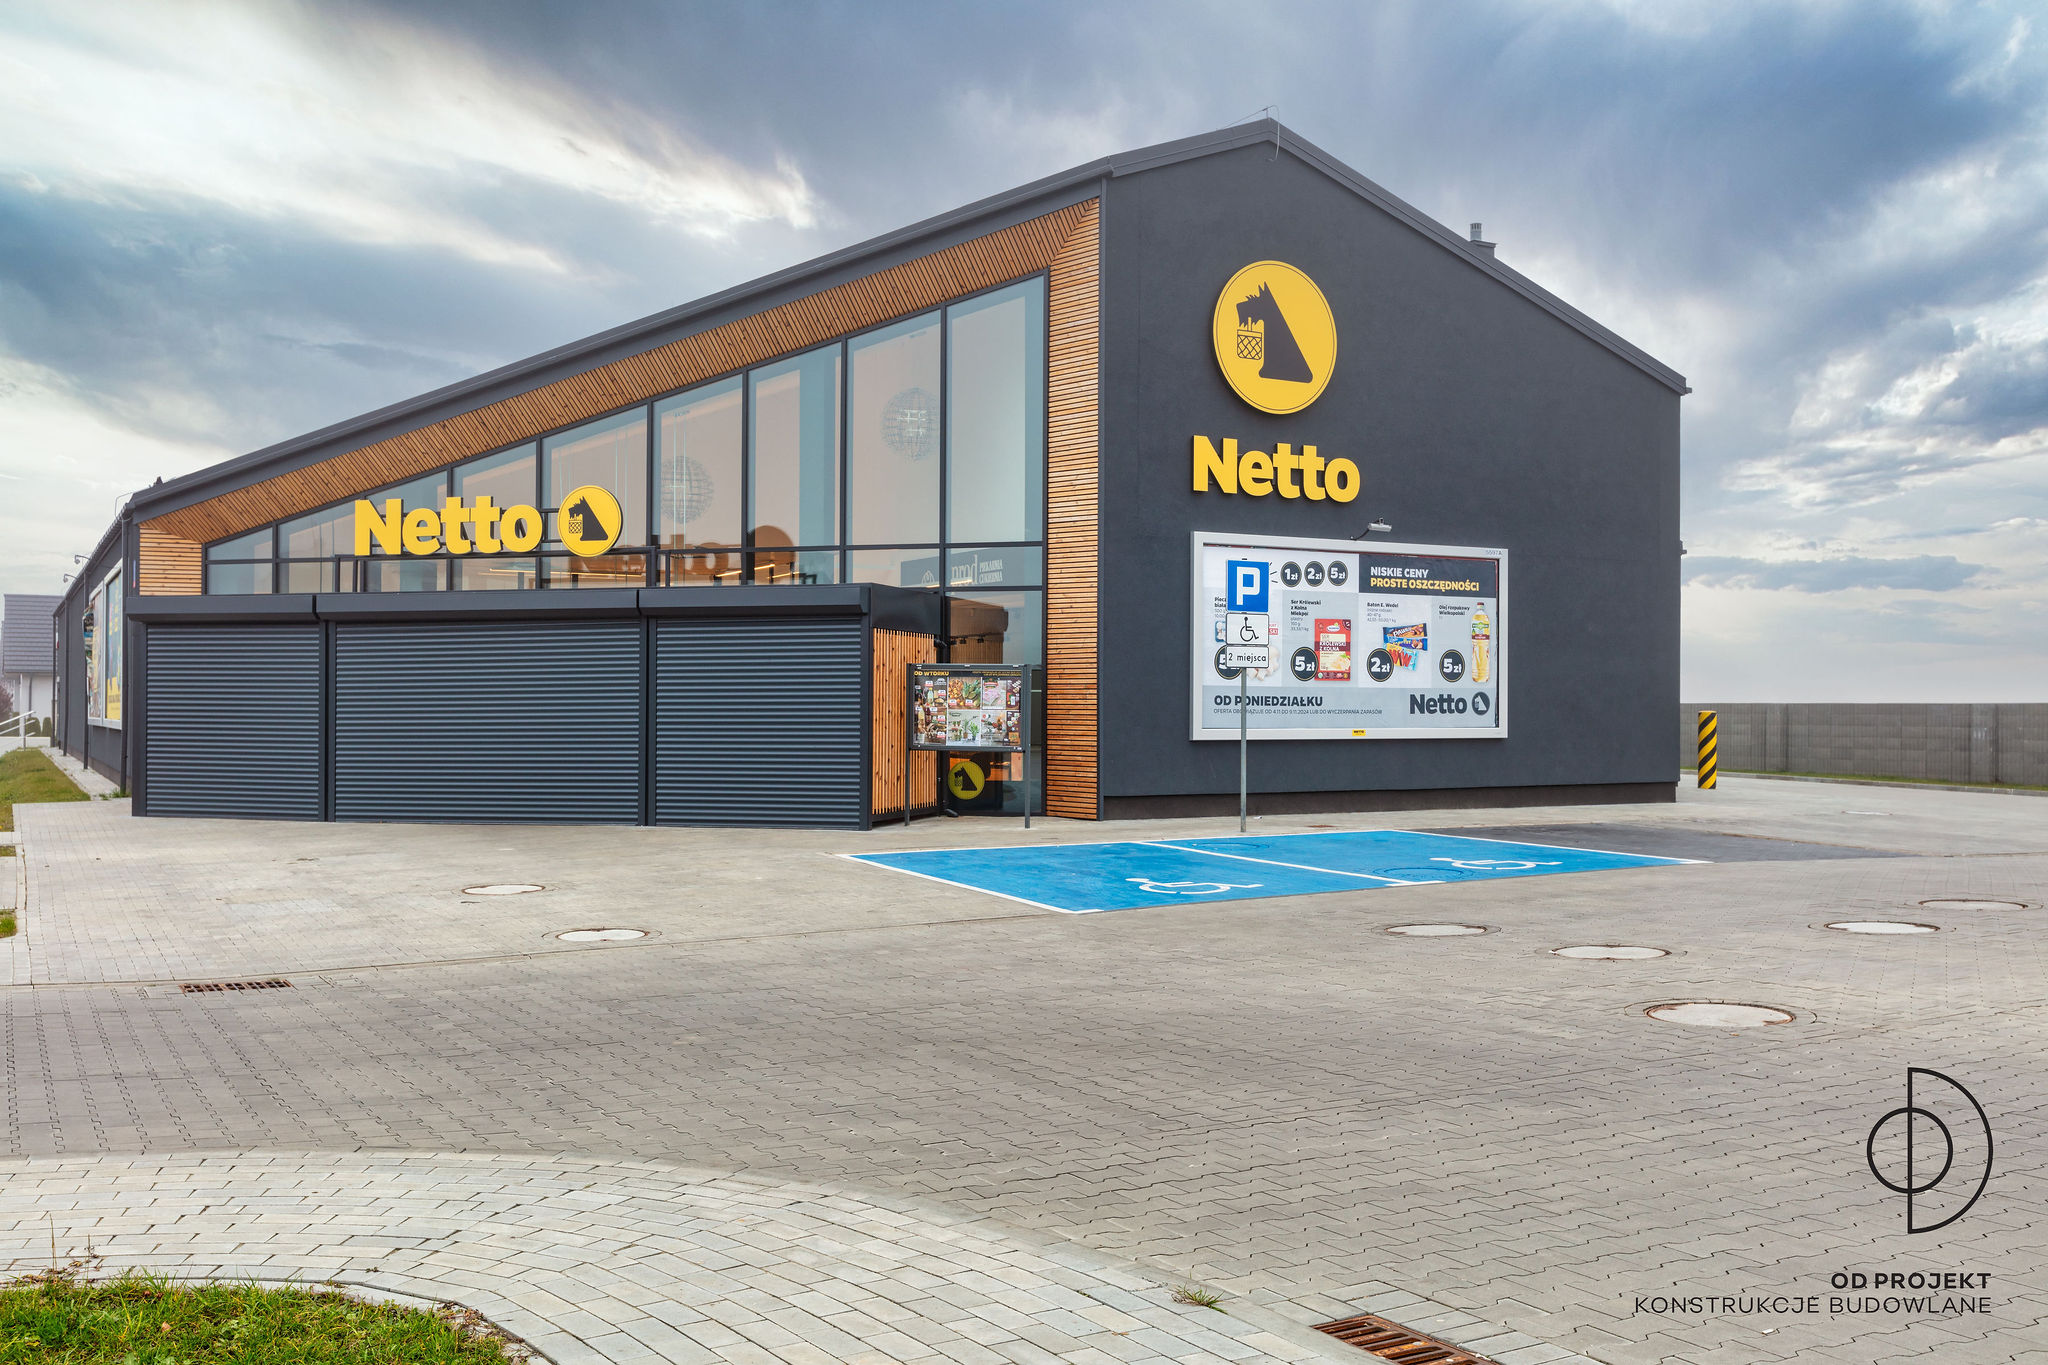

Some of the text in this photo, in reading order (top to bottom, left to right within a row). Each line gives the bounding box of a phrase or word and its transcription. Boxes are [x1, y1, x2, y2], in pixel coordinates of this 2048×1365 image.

[1193, 435, 1360, 502] Netto
[354, 495, 542, 556] Netto
[1370, 566, 1428, 578] NISKIE CENY
[1236, 566, 1260, 606] P
[1370, 578, 1480, 592] PROSTE OSZCZĘDNOŚCI
[1228, 653, 1233, 661] 2
[1237, 653, 1266, 663] miejsca
[1214, 695, 1323, 707] OD PONIEDZIAŁKU
[1410, 694, 1467, 714] Netto
